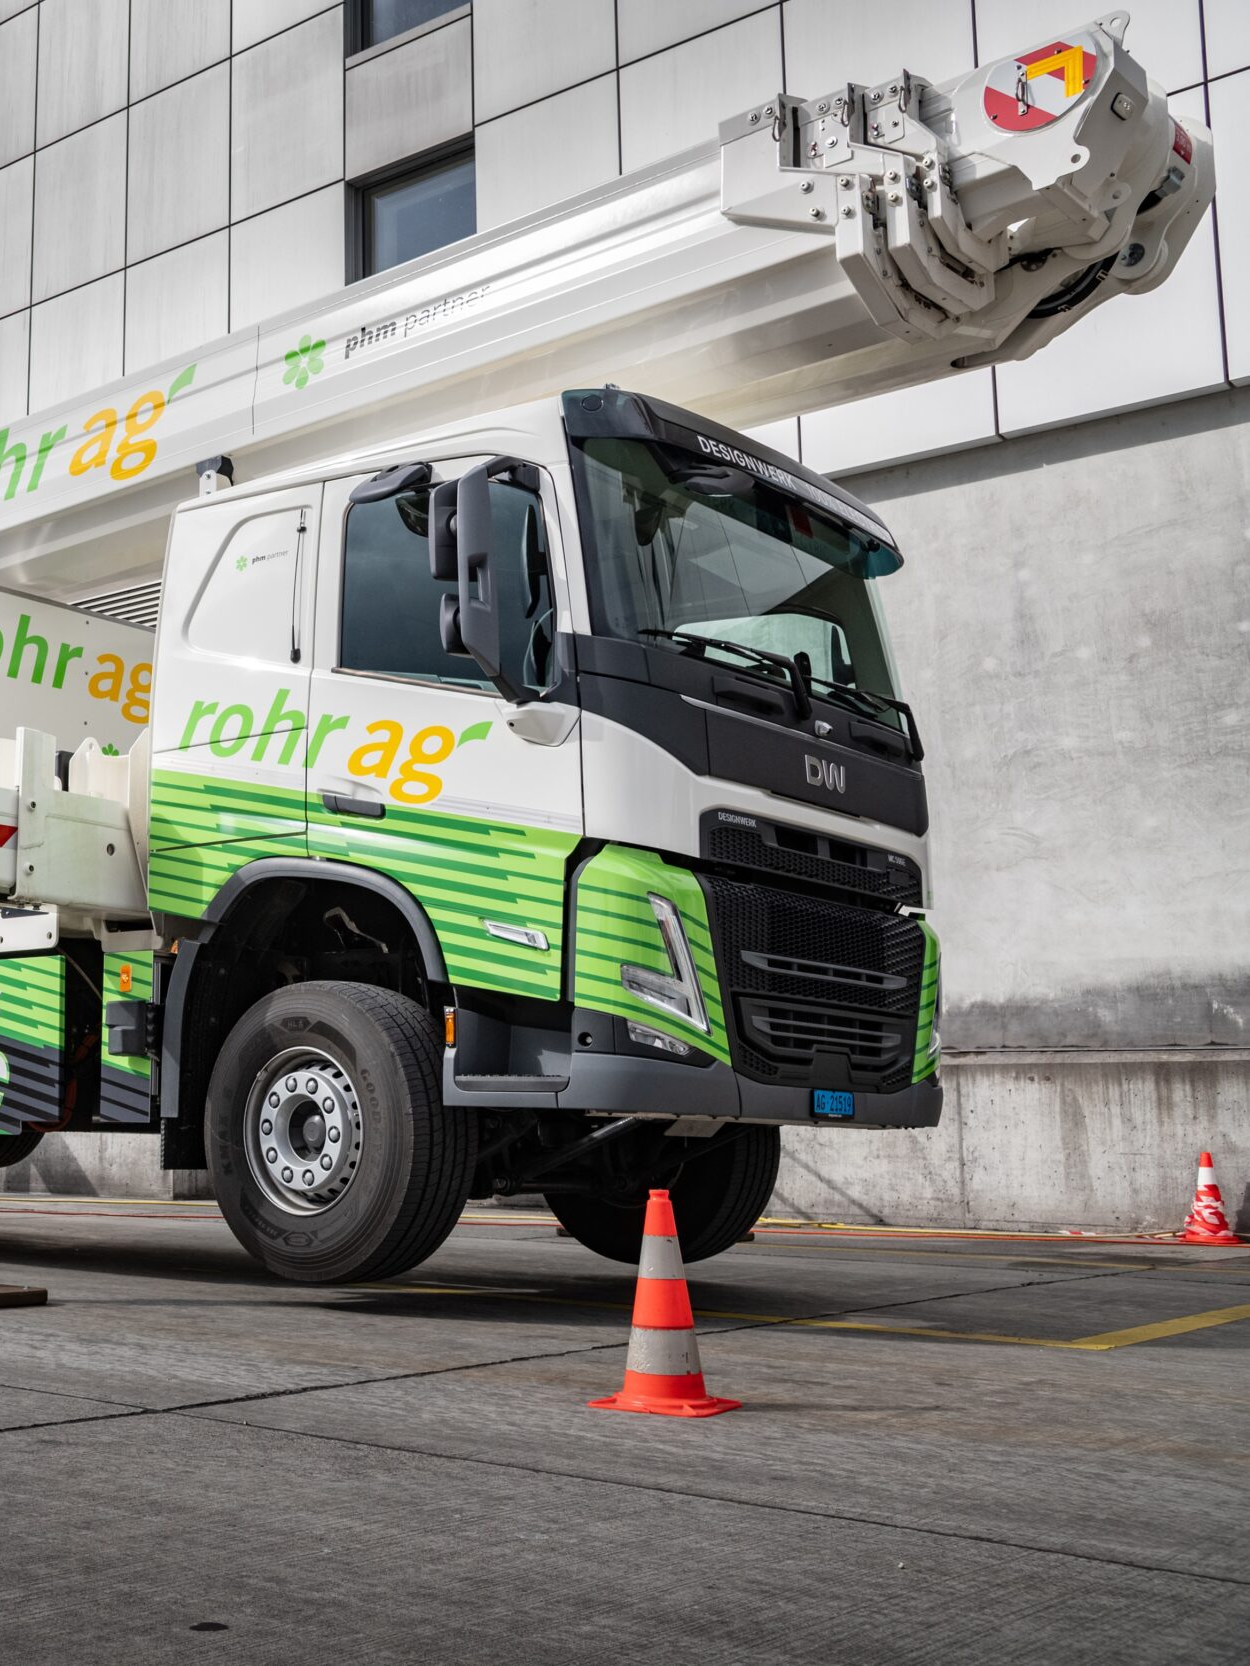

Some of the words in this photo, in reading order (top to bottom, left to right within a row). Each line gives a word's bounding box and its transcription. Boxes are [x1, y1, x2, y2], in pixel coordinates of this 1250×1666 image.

[344, 321, 397, 360] phm
[404, 285, 491, 338] partner
[68, 390, 165, 482] ag
[697, 435, 798, 491] DESIGNWERK
[88, 653, 153, 725] ag
[177, 688, 351, 769] rohr
[347, 719, 456, 804] ag
[804, 753, 846, 794] DW
[717, 811, 757, 828] DESIGNWERK
